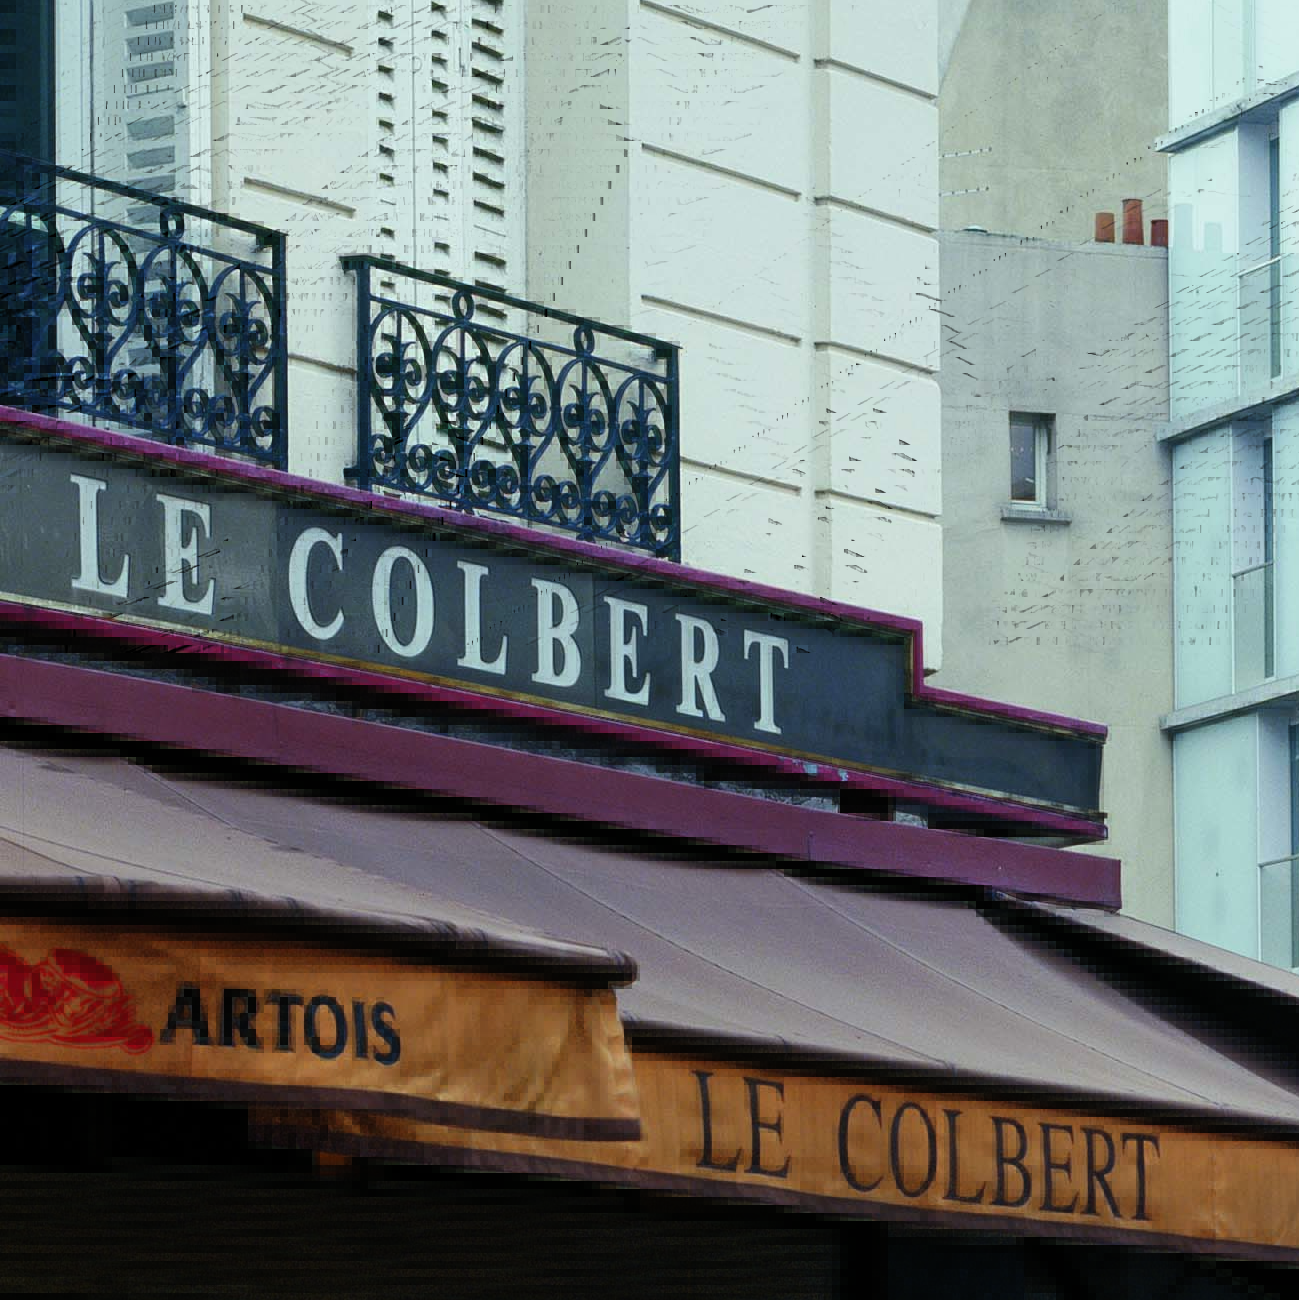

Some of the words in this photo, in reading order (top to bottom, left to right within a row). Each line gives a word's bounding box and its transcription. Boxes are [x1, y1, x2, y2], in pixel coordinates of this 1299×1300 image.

[70, 474, 215, 616] LE
[288, 527, 790, 735] COLBERT
[159, 981, 401, 1066] ARTOIS
[691, 1070, 792, 1178] LE
[838, 1094, 1161, 1222] COLBERT
